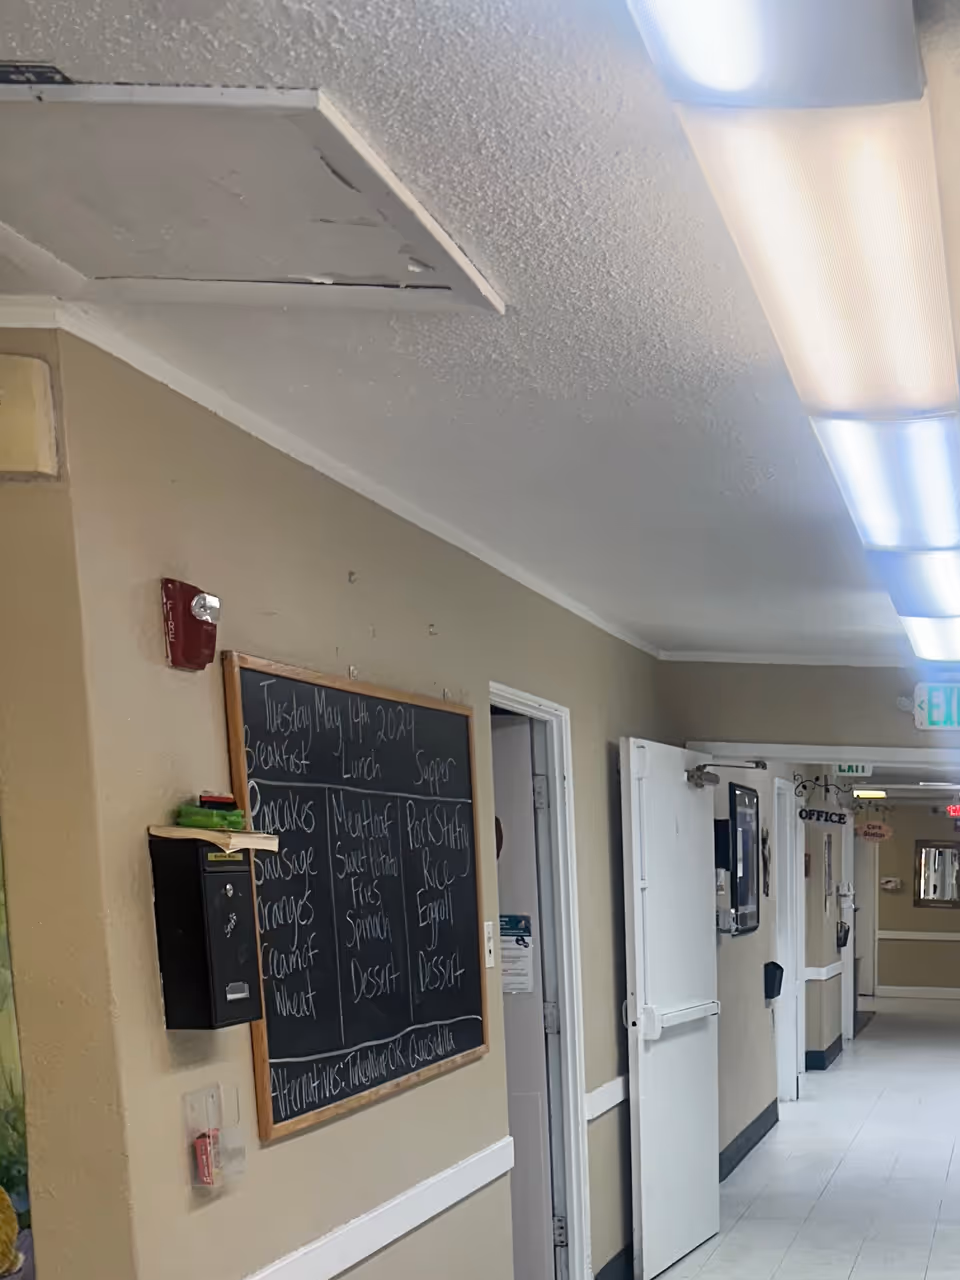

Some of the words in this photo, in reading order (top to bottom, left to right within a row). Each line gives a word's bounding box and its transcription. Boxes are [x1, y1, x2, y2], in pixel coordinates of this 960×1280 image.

[167, 600, 175, 641] FIRE
[260, 679, 311, 751] Tuesday
[314, 687, 341, 755] May
[349, 697, 370, 743] 14th
[376, 704, 415, 750] 2024
[243, 724, 312, 774] Breakfast
[341, 743, 382, 781] Lunch
[413, 749, 457, 795] Supper
[248, 780, 316, 834] Pancakes
[799, 808, 847, 825] OFFICE
[253, 846, 317, 897] Sausage
[351, 875, 382, 907] Fries
[422, 846, 455, 891] Rice
[256, 889, 315, 950] Oranges
[345, 908, 393, 950] Spinach
[272, 967, 317, 1020] Wheat
[351, 951, 400, 1004] Dessert
[418, 949, 466, 993] Dessert
